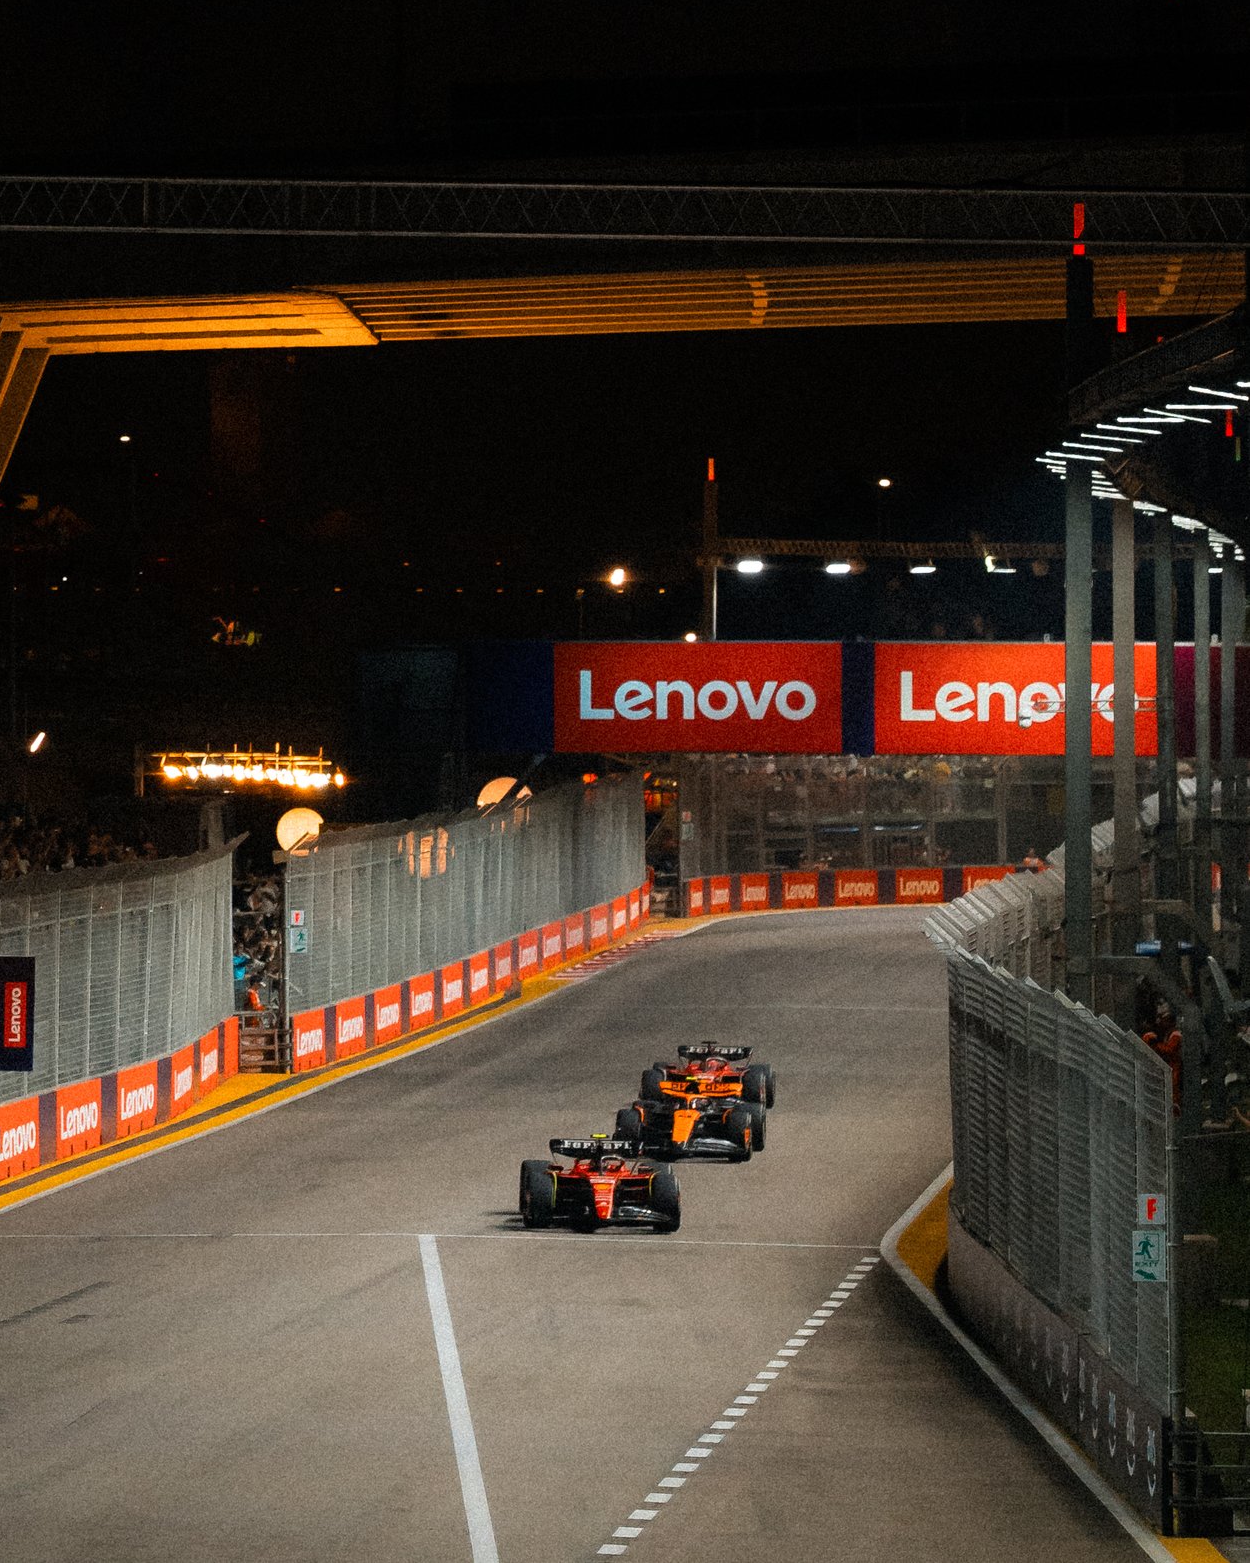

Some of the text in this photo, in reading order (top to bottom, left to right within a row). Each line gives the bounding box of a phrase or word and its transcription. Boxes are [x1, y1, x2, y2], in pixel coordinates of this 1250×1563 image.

[579, 669, 817, 721] Lenovo
[837, 879, 875, 899] Lenovo
[899, 877, 940, 897] Lenovo
[8, 987, 22, 1043] Lenovo
[60, 1101, 99, 1141] Lenovo
[120, 1083, 155, 1121] Lenovo
[1146, 1198, 1158, 1221] F
